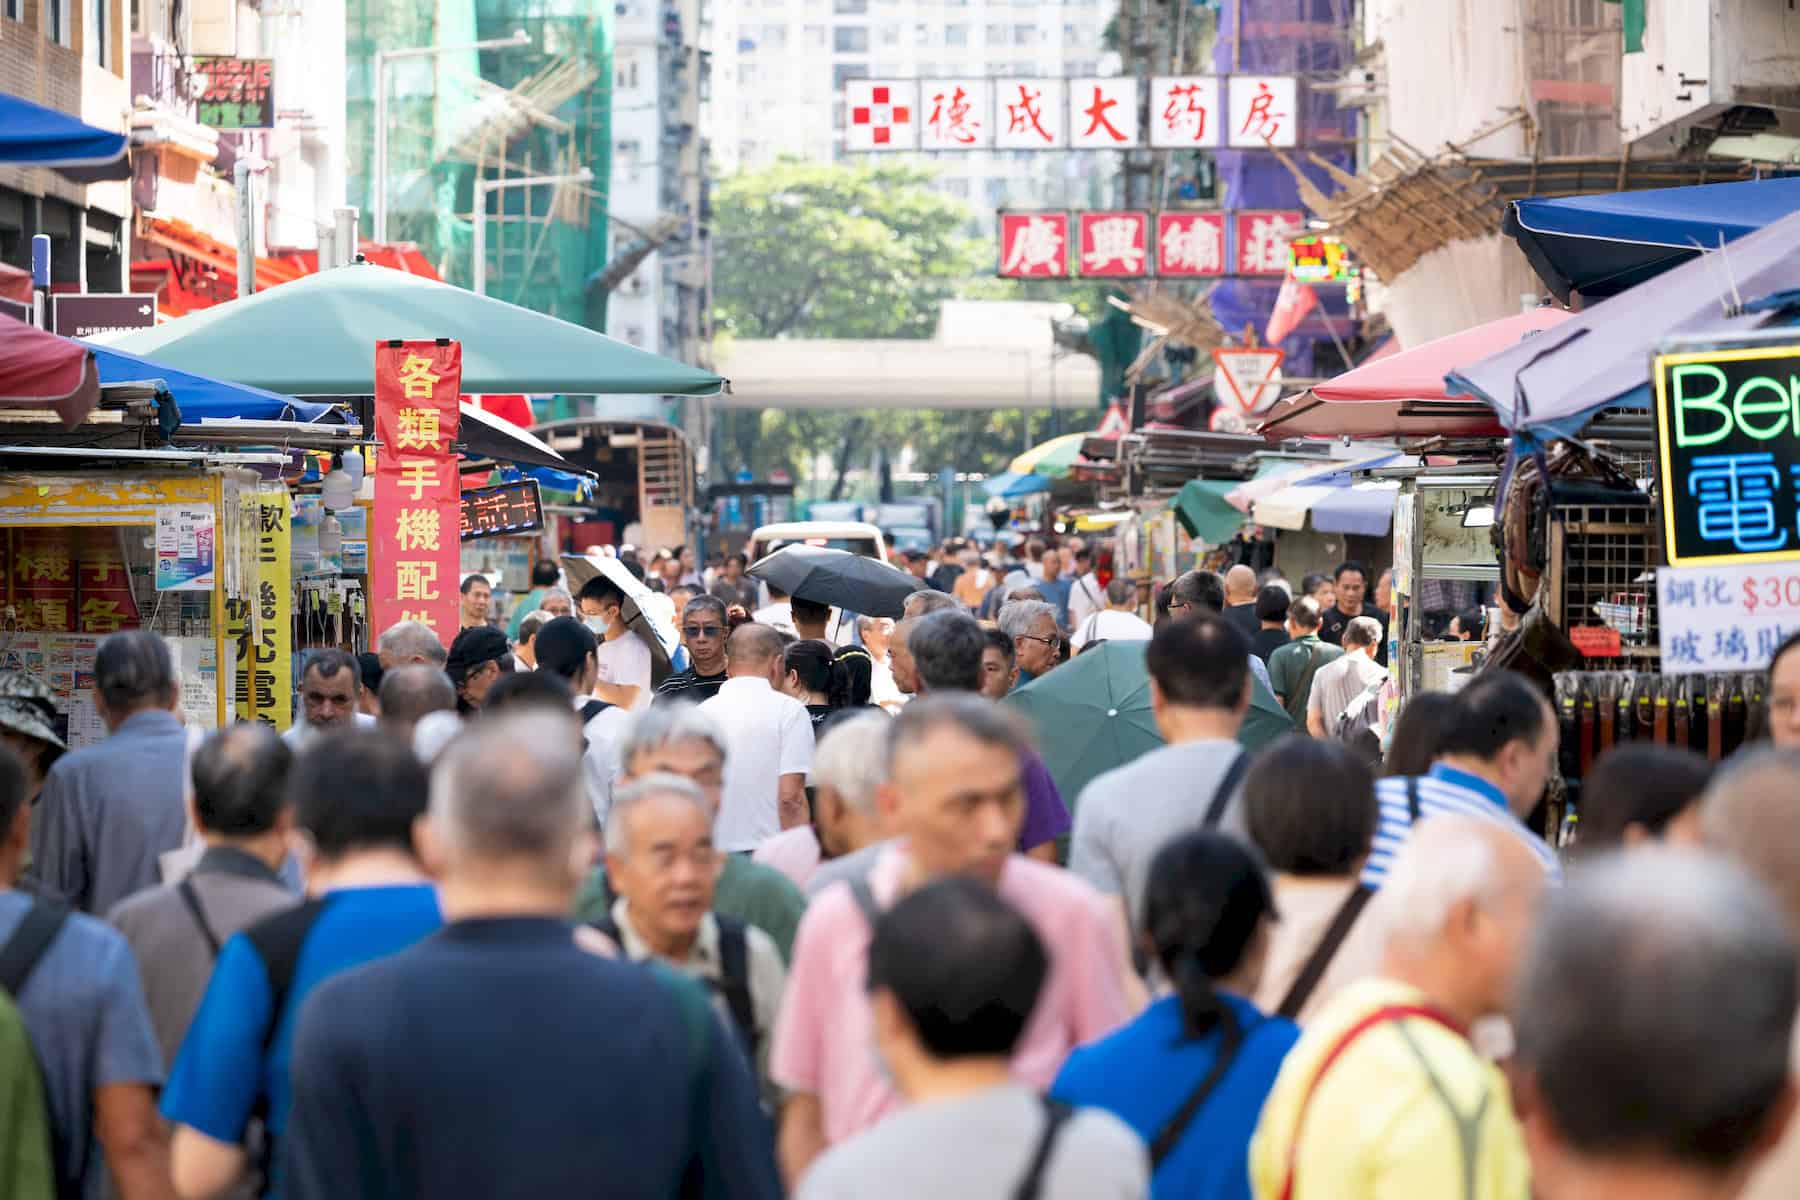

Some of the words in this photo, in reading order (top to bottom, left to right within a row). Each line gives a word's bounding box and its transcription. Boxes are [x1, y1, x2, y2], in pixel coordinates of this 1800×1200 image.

[928, 82, 1286, 143] 德成大药房
[1672, 364, 1800, 448] Be
[1688, 453, 1800, 552] 電
[1743, 575, 1800, 616] $30
